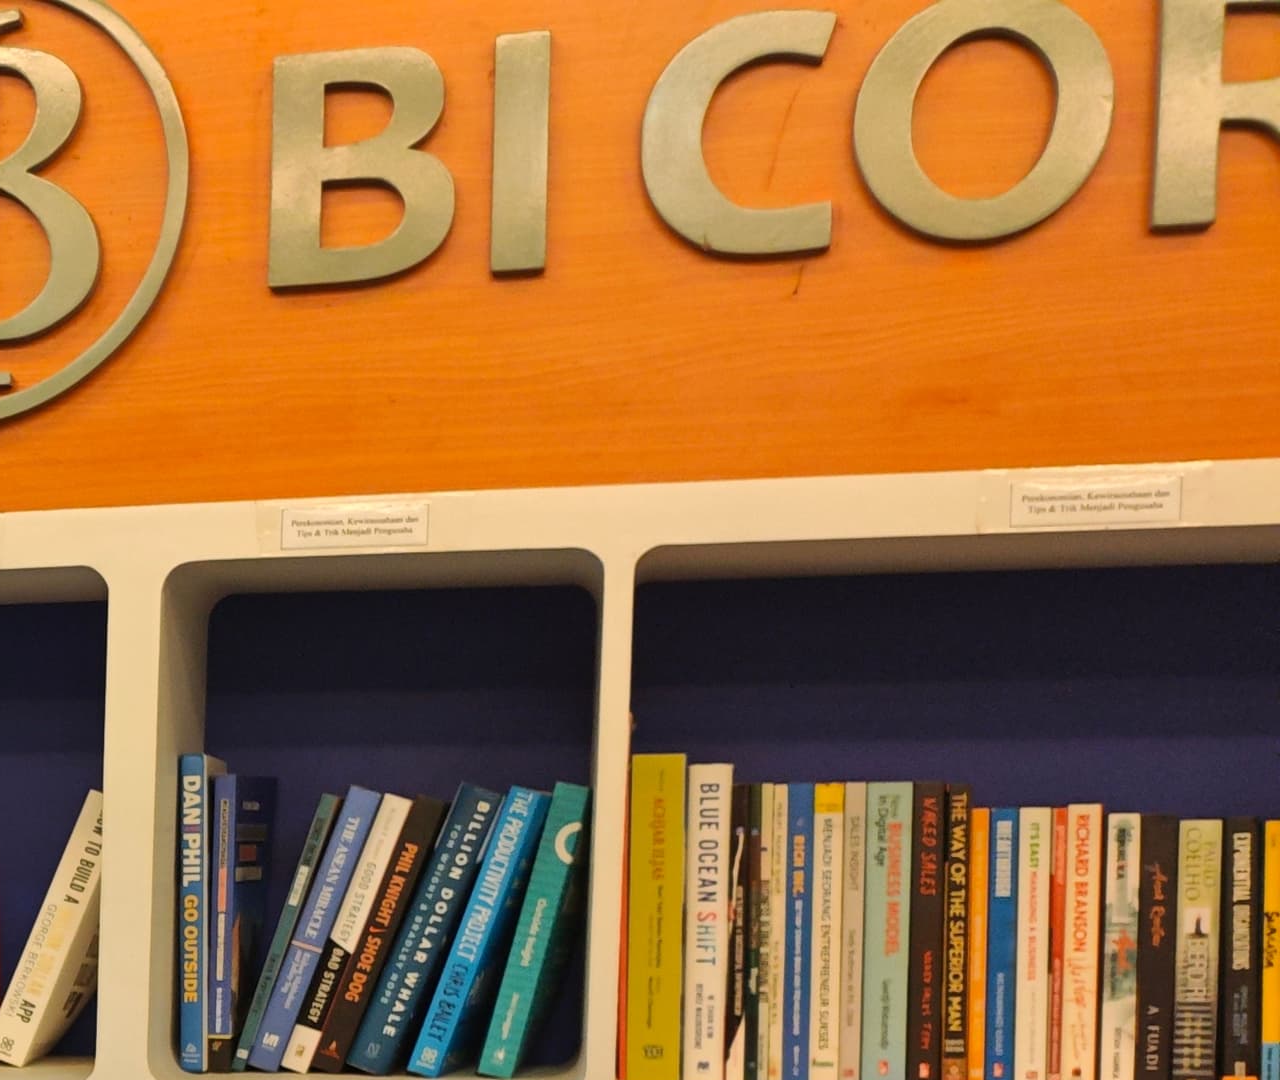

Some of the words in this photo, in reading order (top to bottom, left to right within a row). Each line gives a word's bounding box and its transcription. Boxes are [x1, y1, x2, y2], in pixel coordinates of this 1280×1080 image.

[268, 30, 550, 292] BI
[183, 775, 200, 823] DAN
[508, 787, 535, 817] THE
[699, 782, 720, 830] BLUE
[951, 793, 967, 819] THE
[447, 800, 491, 881] BILLION
[849, 815, 859, 847] SALES
[875, 807, 888, 842] Digital
[950, 823, 966, 859] WAY
[1074, 814, 1089, 876] RICHARD
[84, 839, 103, 857] TO
[183, 833, 200, 886] PHIL
[394, 841, 418, 875] PHIL
[476, 815, 523, 904] PRODUCTIVITY
[849, 850, 858, 891] INSIGHT
[875, 846, 886, 867] Age
[885, 821, 902, 897] BUSINESS
[1182, 827, 1204, 901] COELHO
[68, 857, 94, 893] BUILD
[357, 860, 377, 890] GOOD
[697, 839, 718, 903] OCEAN
[919, 852, 936, 896] SALES
[950, 862, 965, 885] OF
[63, 894, 79, 906] A
[184, 894, 198, 922] GO
[337, 890, 366, 944] STRATEGY
[373, 874, 404, 926] KNIGHT
[820, 869, 832, 920] SEORANG
[949, 889, 964, 917] THE
[1073, 881, 1088, 952] BRANSON
[412, 886, 454, 963] DOLLAR
[455, 904, 492, 962] PROJECT
[696, 911, 716, 966] SHIFT
[184, 925, 197, 1003] OUTSIDE
[327, 947, 344, 971] BAD
[356, 935, 381, 971] SHOE
[819, 924, 831, 1006] ENTREPRENEUR
[947, 920, 964, 993] SUPERIOR
[306, 970, 335, 1023] STRATEGY
[343, 971, 366, 1003] DOG
[381, 969, 420, 1038] WHALE
[15, 999, 35, 1023] APP
[947, 996, 962, 1031] MAN
[1147, 1005, 1159, 1015] A
[1146, 1025, 1159, 1070] FUADI
